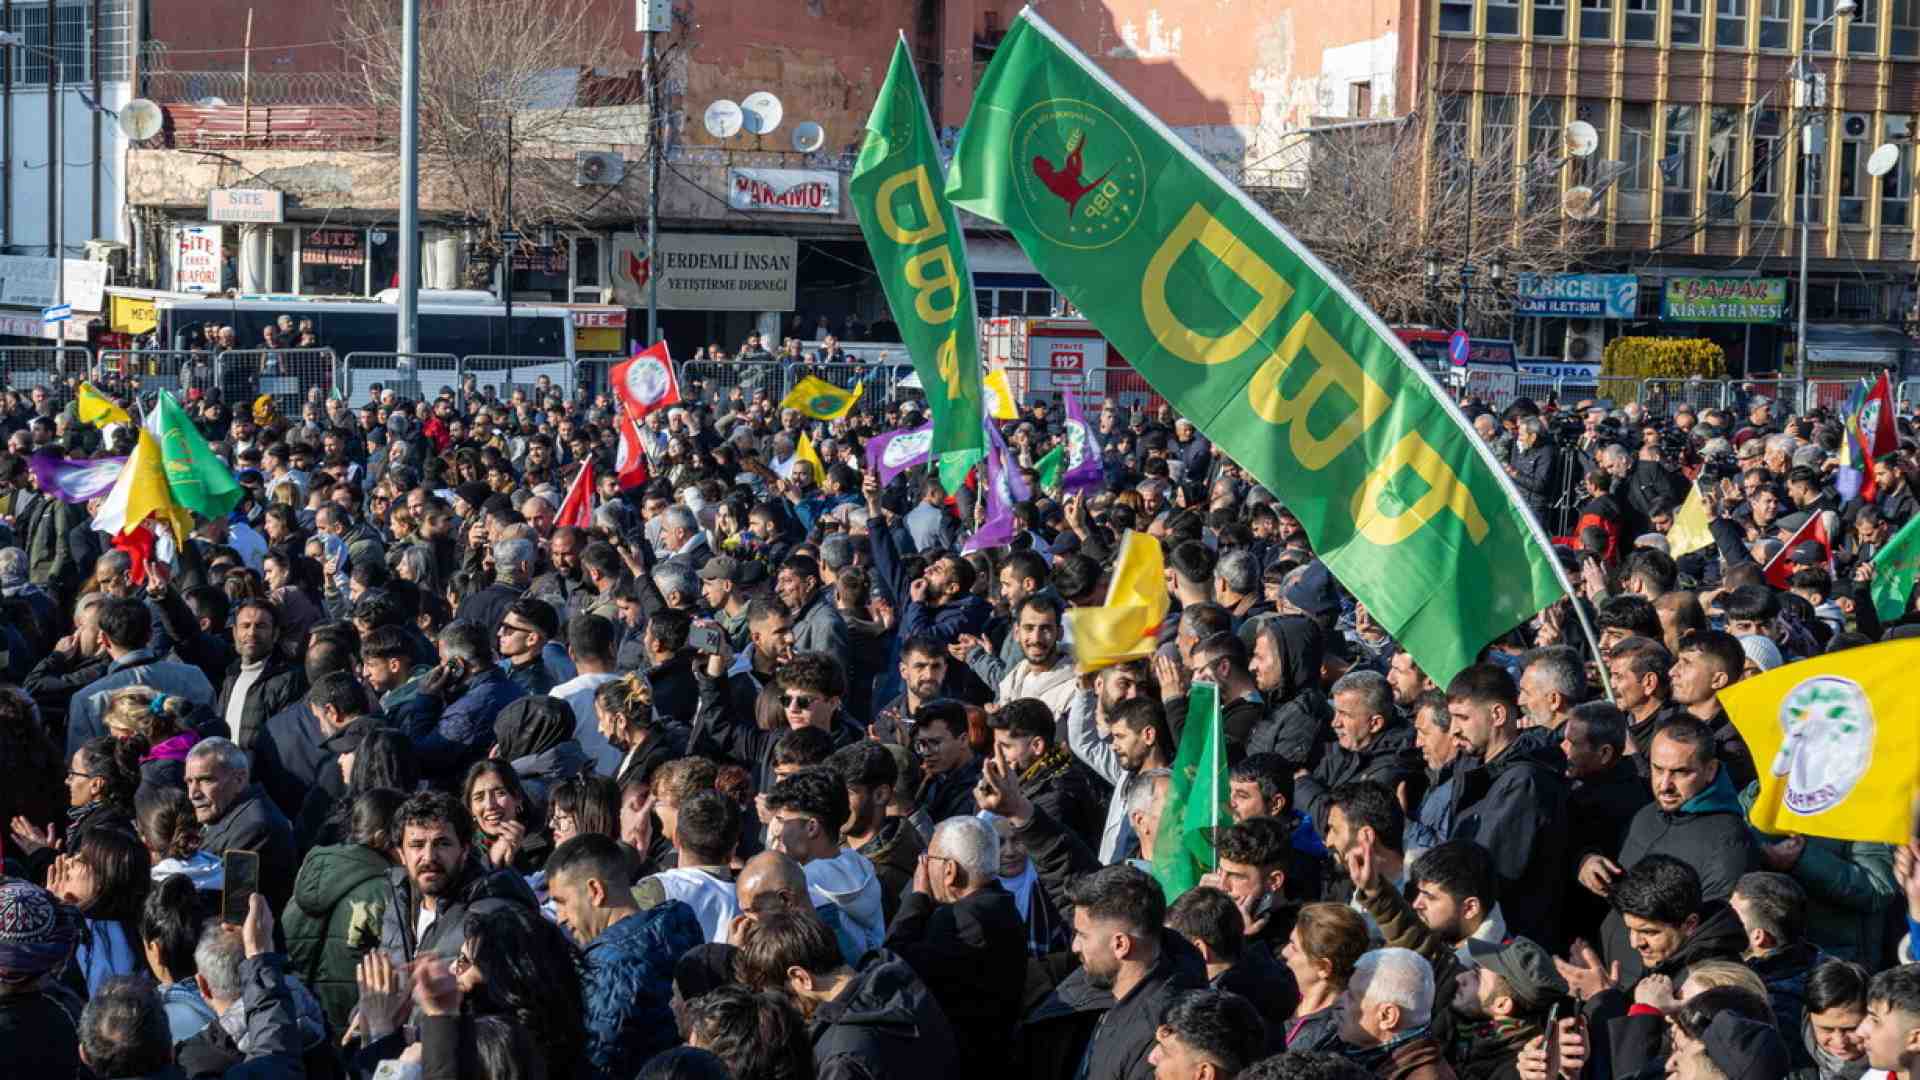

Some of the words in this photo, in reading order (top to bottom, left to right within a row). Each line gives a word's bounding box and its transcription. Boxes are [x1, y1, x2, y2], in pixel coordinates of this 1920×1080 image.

[667, 251, 739, 270] ERDEMLİ
[743, 251, 791, 270] İNSAN
[668, 277, 736, 293] YETİŞTİRME
[739, 277, 787, 292] DERNEĞİ
[1056, 355, 1079, 368] 112
